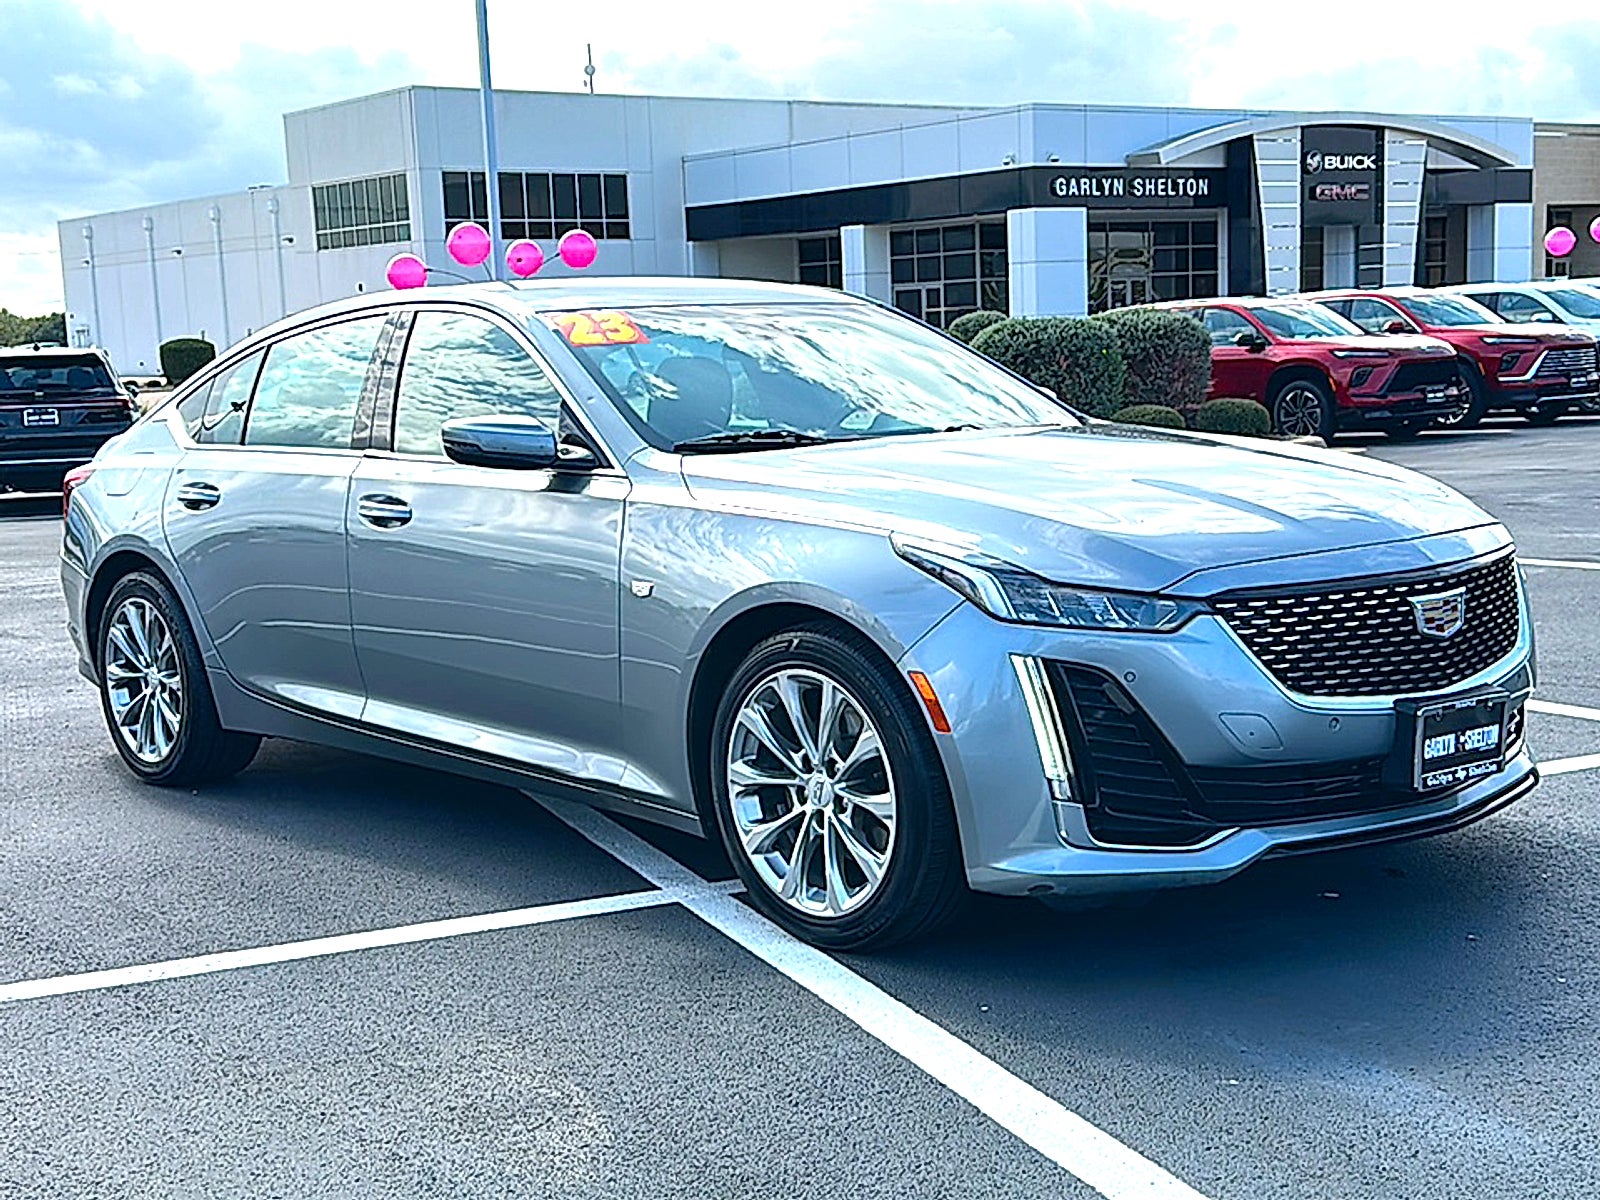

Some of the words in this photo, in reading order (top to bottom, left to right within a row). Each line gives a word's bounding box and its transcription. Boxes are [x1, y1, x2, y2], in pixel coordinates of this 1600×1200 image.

[1324, 155, 1377, 170] BUICK
[1055, 177, 1124, 196] GARLYN
[1133, 177, 1209, 196] SHELTON
[1315, 184, 1370, 200] GMC
[551, 312, 640, 344] 23
